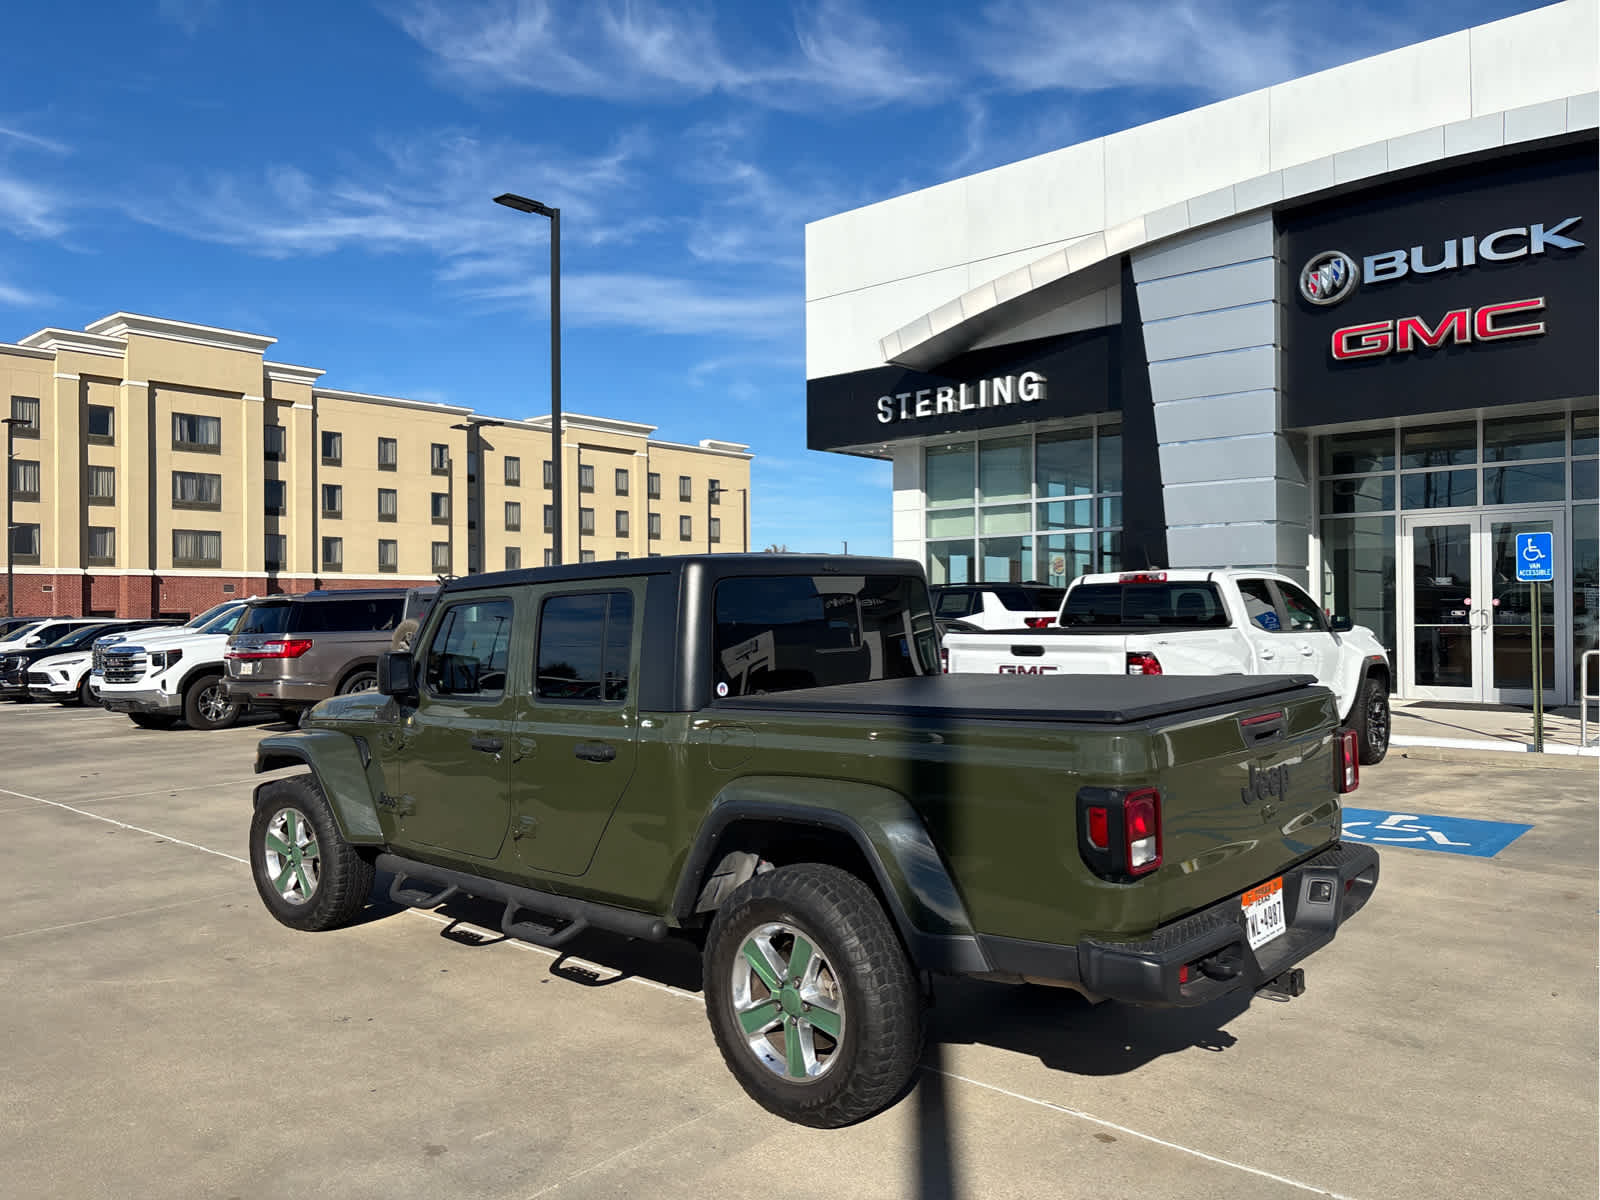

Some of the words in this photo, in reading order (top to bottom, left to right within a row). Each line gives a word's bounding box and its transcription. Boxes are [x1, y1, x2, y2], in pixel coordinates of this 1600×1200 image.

[1363, 216, 1585, 284] BUICK
[1331, 297, 1545, 360] GMC
[877, 371, 1047, 424] STERLING
[1240, 763, 1288, 806] Jeep
